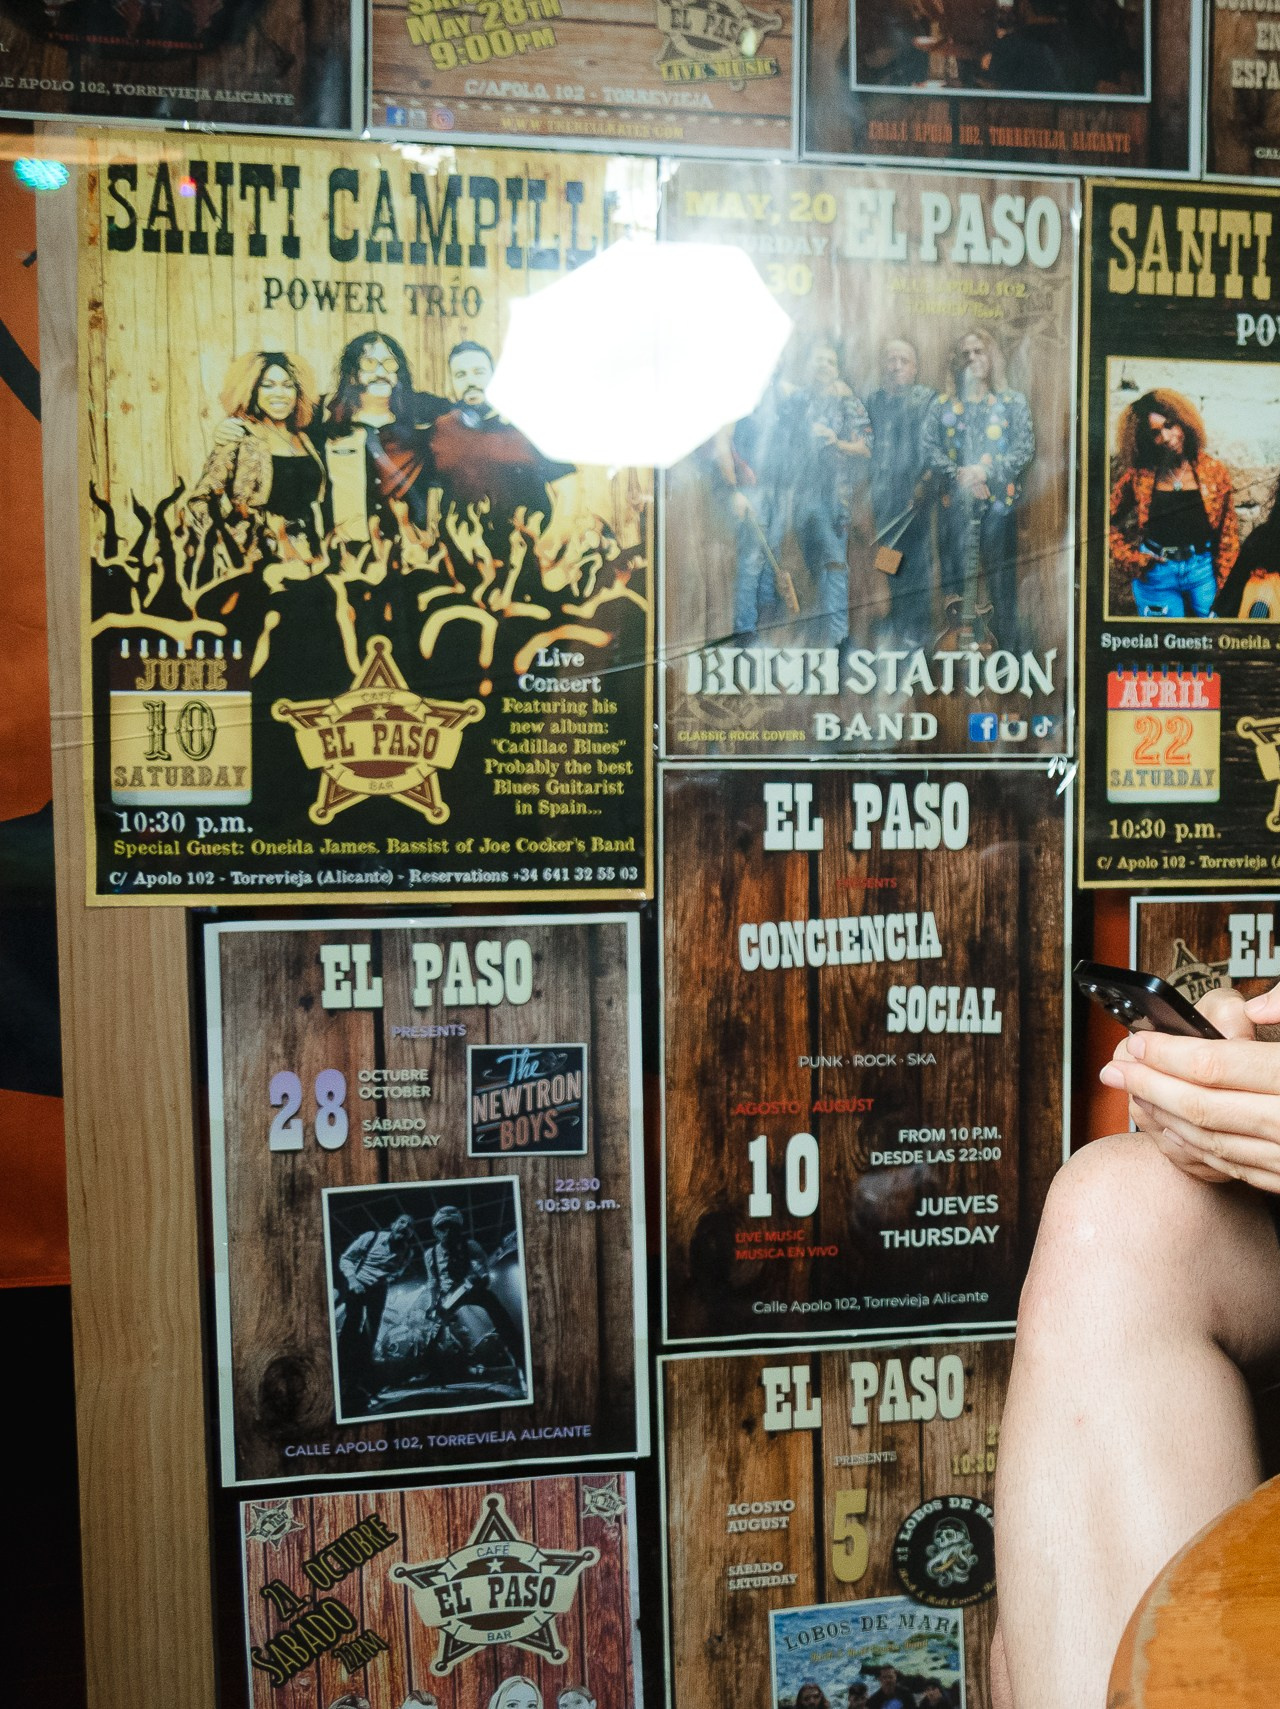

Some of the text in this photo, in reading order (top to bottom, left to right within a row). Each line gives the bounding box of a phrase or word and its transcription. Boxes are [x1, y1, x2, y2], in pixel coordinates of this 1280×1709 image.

[18, 78, 75, 91] APOLO
[79, 80, 111, 96] 102,
[113, 83, 212, 102] TORREVIEJA
[214, 88, 296, 106] ALICANTE
[106, 159, 302, 260] SANTI
[788, 190, 838, 225] 20
[845, 187, 1063, 270] EL PASO
[1108, 202, 1273, 301] SANTI
[263, 276, 388, 315] POWER
[1099, 632, 1159, 652] Special
[1163, 633, 1213, 651] Guest:
[1217, 634, 1272, 650] Oneida
[537, 648, 586, 668] Live
[135, 658, 228, 691] JUNE
[518, 673, 603, 694] Concert
[845, 646, 1059, 699] STATION
[1119, 679, 1210, 709] APRIL
[501, 697, 618, 718] Featuring his
[142, 699, 218, 761] 10
[509, 718, 610, 735] new album:
[813, 711, 939, 742] BAND
[318, 722, 440, 761] EL PASO
[1132, 714, 1194, 767] 22
[113, 764, 248, 788] SATURDAY
[483, 758, 635, 777] Probably the best
[1110, 768, 1217, 788] SATURDAY
[493, 778, 625, 796] Blues Guitarist
[514, 800, 534, 816] in
[762, 781, 970, 852] EL PASO
[118, 811, 254, 838] 10:30 p.m.
[1108, 819, 1222, 843] 10:30 p.m.
[113, 836, 636, 859] Special Guest: Oneida Bassist of Joe Cocker's Band
[1096, 854, 1268, 872] C/ Apolo 102 Torrevieja
[109, 866, 639, 888] C/ Apolo 102 Torrevieja (Alicante) Reservations 641 32 03
[737, 911, 943, 972] CONCIENCIA
[319, 938, 535, 1010] EL PASO
[886, 984, 1003, 1035] SOCIAL
[391, 1023, 468, 1040] PRESENTS
[799, 1053, 937, 1069] PUNK ROCK SKA
[357, 1067, 430, 1083] OCTUBRE
[357, 1085, 432, 1100] OCTOBER
[472, 1069, 582, 1126] NEWTRON
[268, 1067, 349, 1153] 28
[735, 1098, 875, 1116] AGOSTO AUGUST
[362, 1134, 441, 1149] SATURDAY
[500, 1108, 560, 1151] BOYS
[898, 1127, 970, 1144] FROM 10
[870, 1146, 1002, 1167] DESDE LAS 22:00
[554, 1177, 601, 1193] 22:30
[747, 1131, 821, 1219] 10
[535, 1197, 581, 1212] 10:30
[915, 1194, 999, 1217] JUEVES
[735, 1229, 806, 1244] LIVE MUSIC
[880, 1224, 1001, 1249] THURSDAY
[787, 1244, 839, 1259] EN VIVO
[752, 1290, 990, 1315] Calle Apolo 102, Torrevieja Alicante
[761, 1354, 966, 1432] EL PASO
[284, 1424, 593, 1458] CALLE APOLO 102, TORREVIEJA ALICANTE
[727, 1499, 797, 1518] AGOSTO
[727, 1515, 790, 1534] AUGUST
[831, 1487, 870, 1583] 5
[304, 1514, 397, 1590] OCTUBRE
[728, 1573, 799, 1591] SATURDAY
[433, 1575, 557, 1619] EL PASO
[251, 1600, 355, 1685] SABADO
[487, 1630, 513, 1642] BAR
[784, 1613, 951, 1651] LOBOS DE MAR
